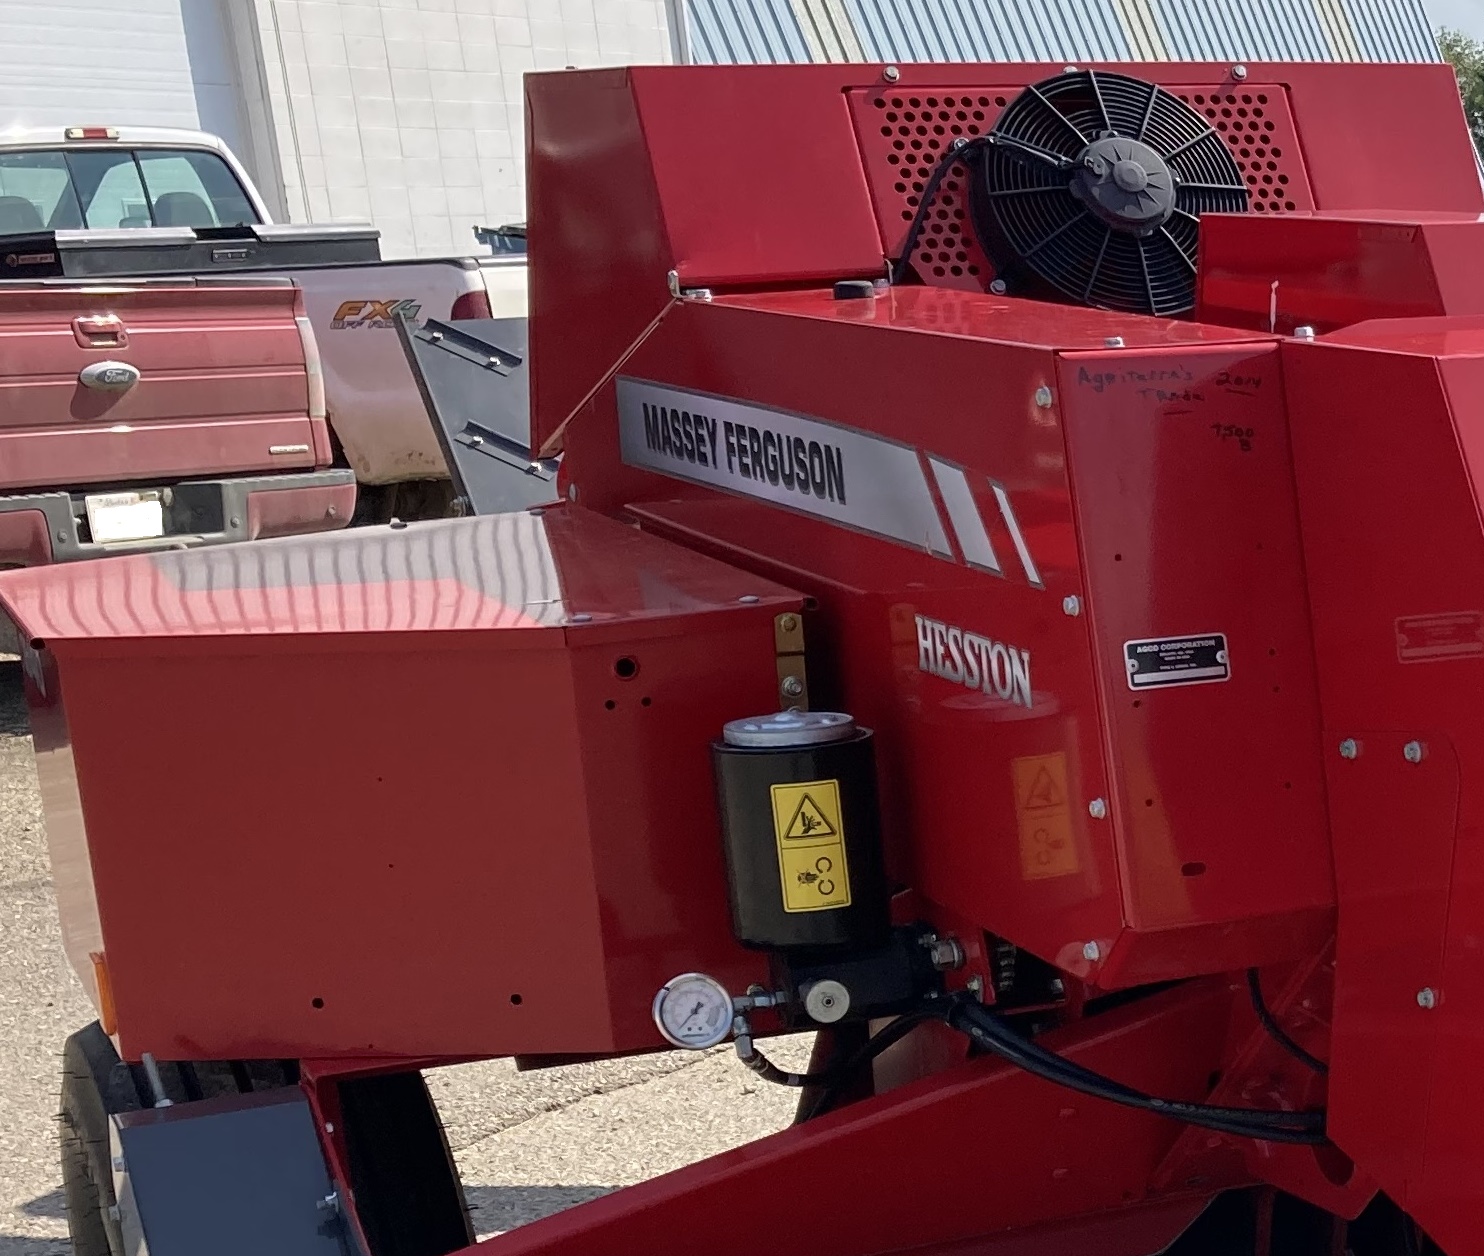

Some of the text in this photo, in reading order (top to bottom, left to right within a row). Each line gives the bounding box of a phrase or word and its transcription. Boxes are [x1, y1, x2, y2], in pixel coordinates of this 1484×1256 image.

[105, 369, 129, 383] Ford
[642, 402, 847, 506] MASSEY FERGUSON
[914, 613, 1032, 709] HESSTON
[1136, 644, 1159, 654] AGCO
[1160, 639, 1216, 651] CORPORATION
